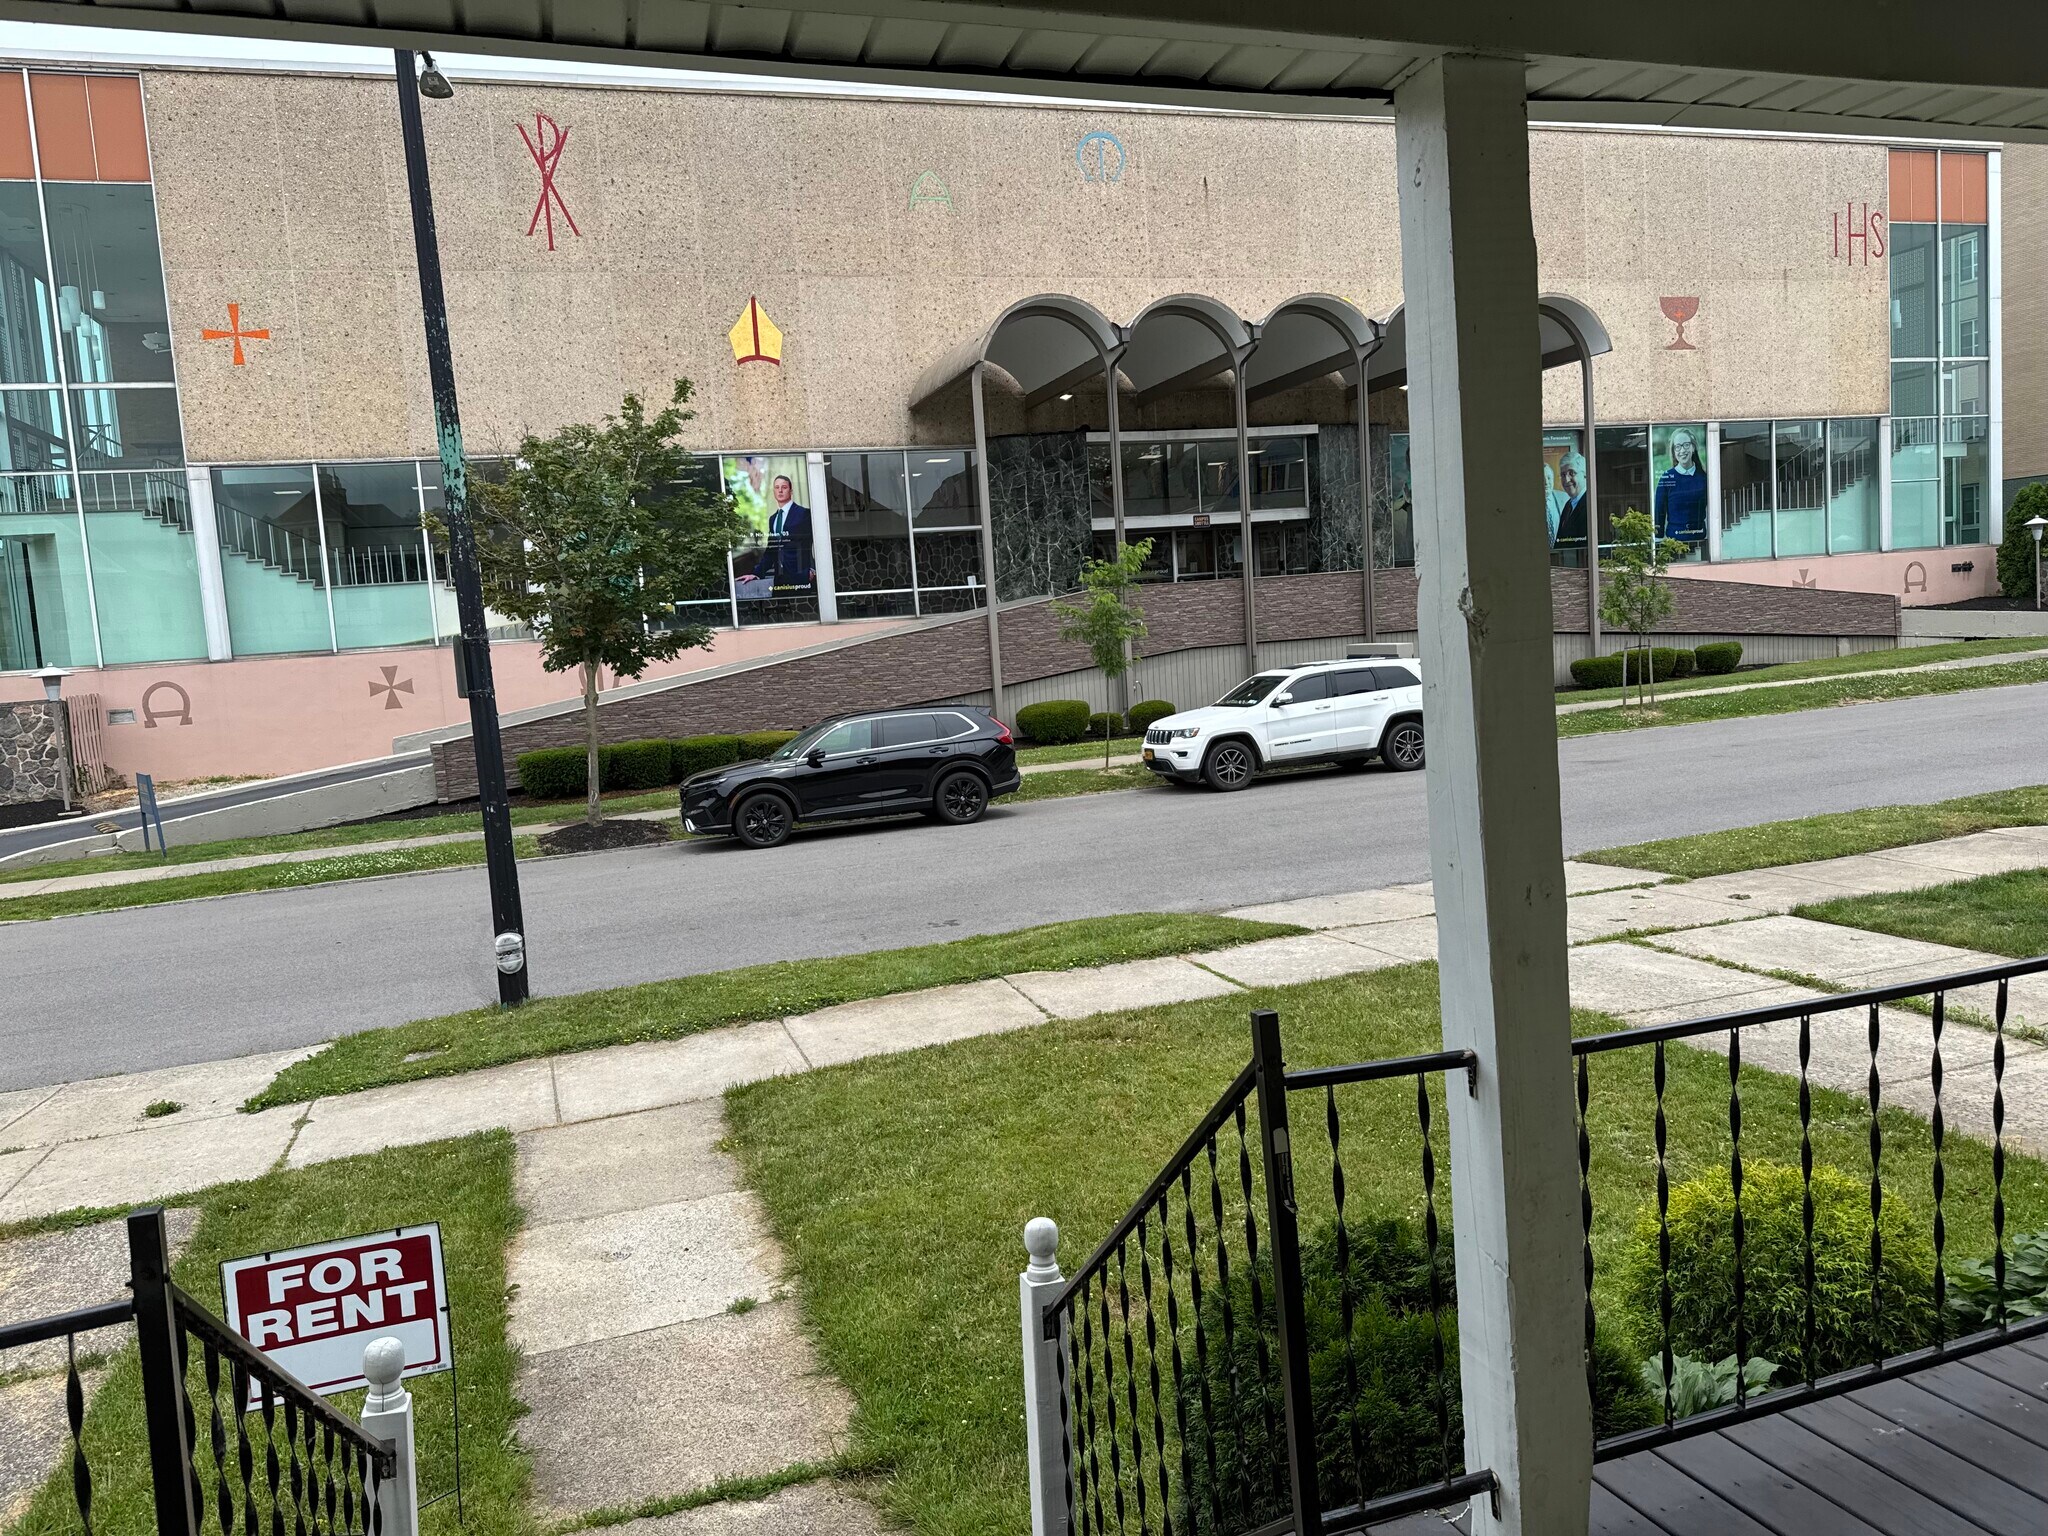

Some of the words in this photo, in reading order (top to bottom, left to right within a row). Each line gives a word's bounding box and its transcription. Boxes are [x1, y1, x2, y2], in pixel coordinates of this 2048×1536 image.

[1834, 202, 1885, 266] IHS
[267, 1248, 404, 1304] FOR
[247, 1280, 428, 1348] RENT
